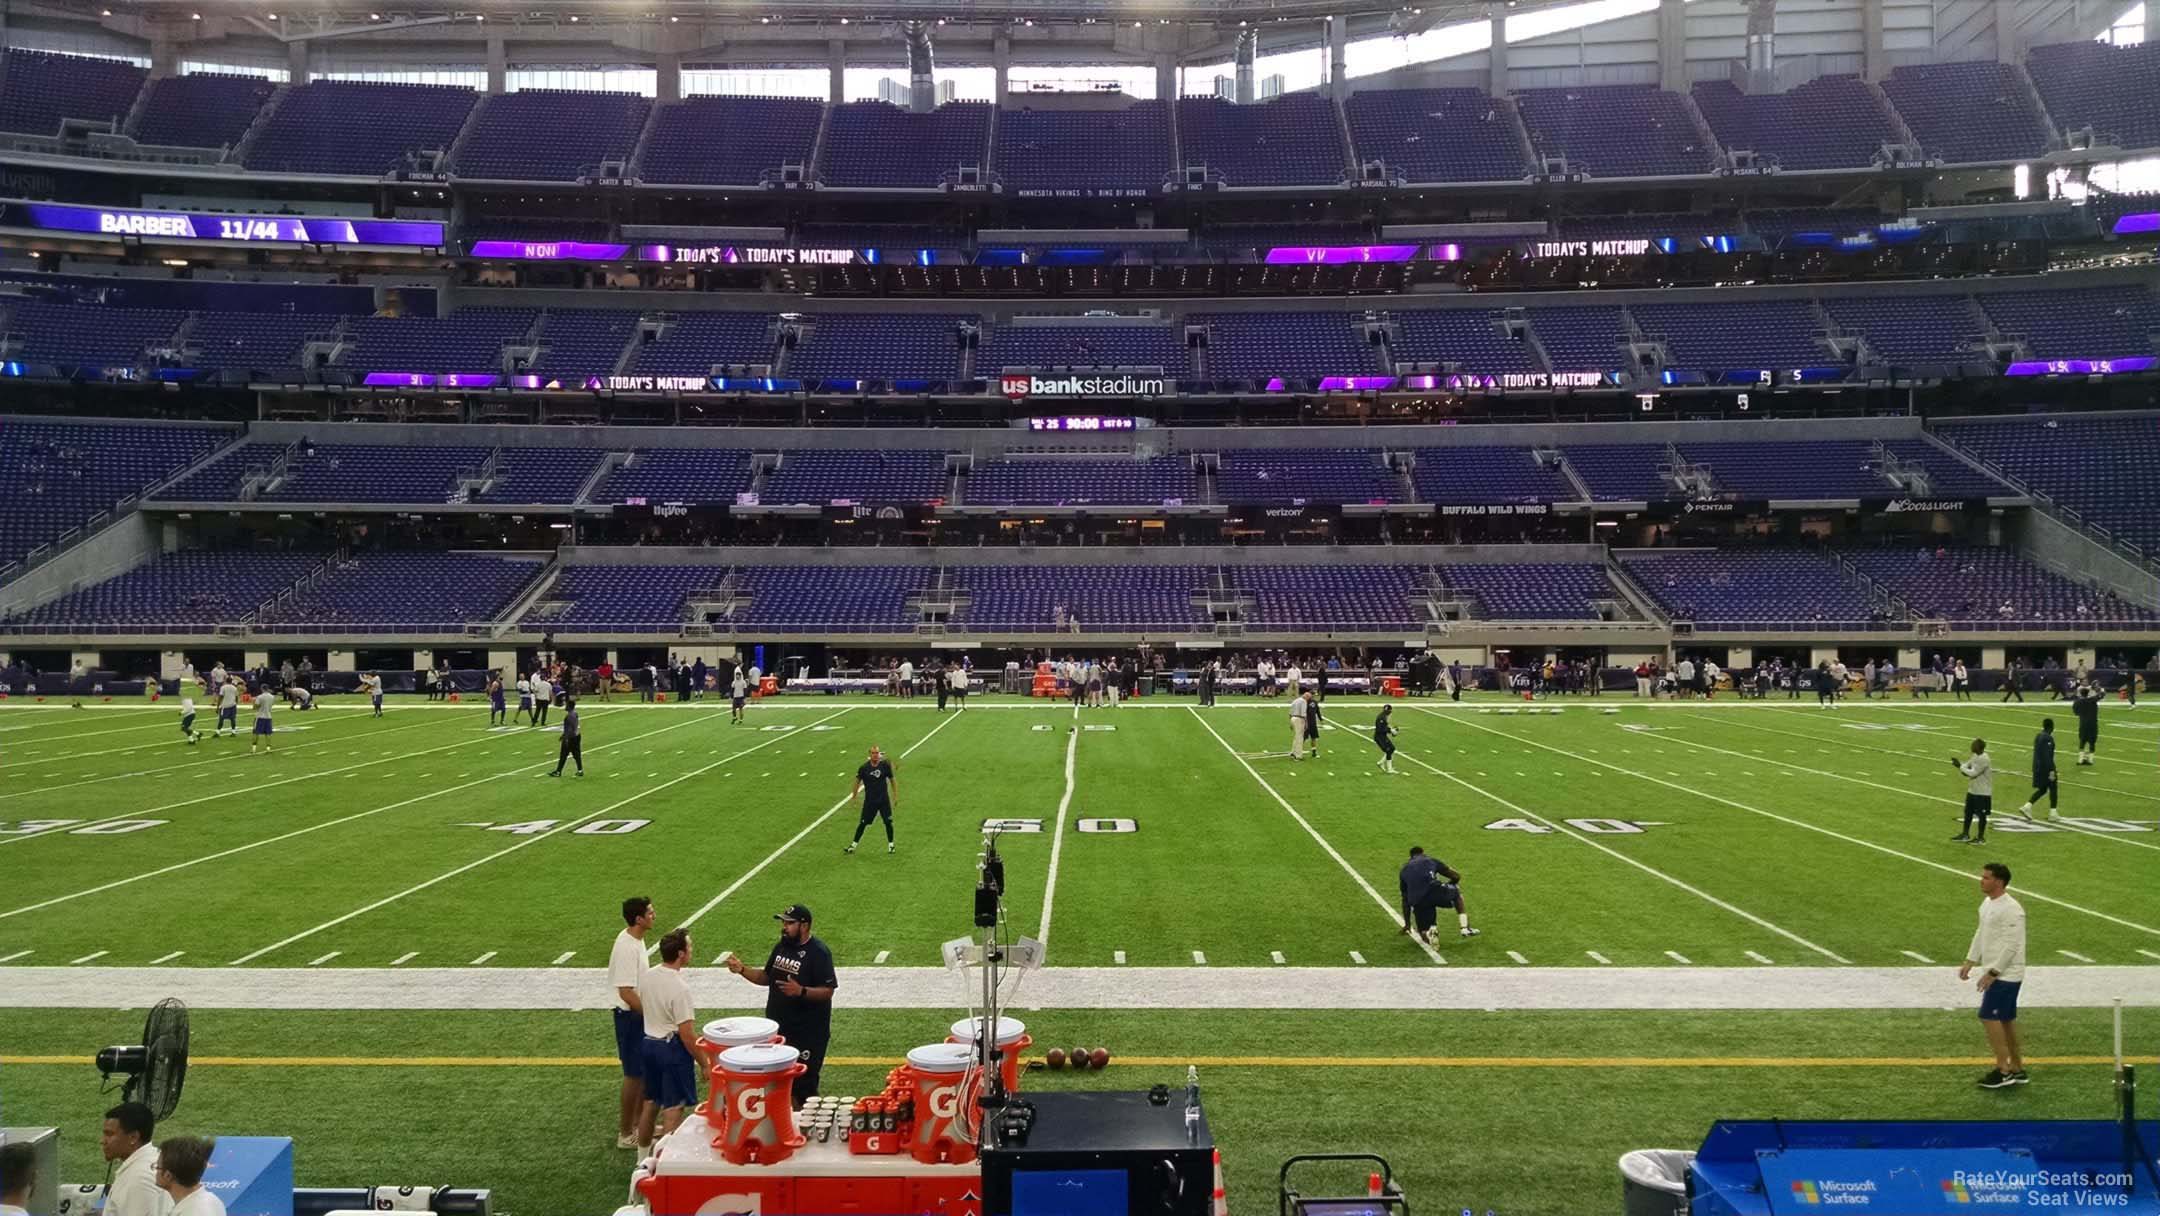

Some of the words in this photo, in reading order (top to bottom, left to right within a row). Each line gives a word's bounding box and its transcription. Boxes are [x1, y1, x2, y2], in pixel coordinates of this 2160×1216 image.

[101, 213, 187, 236] BARBER
[220, 220, 279, 240] 11/44
[746, 248, 796, 263] TODAY'S
[800, 250, 854, 264] MATCHUP
[1537, 241, 1588, 257] TODAY'S
[1592, 240, 1649, 256] MATCHUP
[608, 376, 653, 389] TODAY'S
[657, 377, 707, 391] MATCHUP
[1503, 374, 1548, 387] TODAY'S
[1551, 372, 1602, 386] MATCHUP
[1265, 507, 1301, 517] verizon
[1442, 505, 1486, 515] BUFFALO
[1487, 505, 1513, 514] WILD
[1514, 504, 1547, 514] WINGS
[1901, 498, 1933, 512] Coors
[1933, 502, 1964, 510] LIGHT
[774, 955, 802, 972] RAMS
[737, 1087, 766, 1120] G
[929, 1086, 958, 1118] G
[870, 1118, 881, 1130] G
[867, 1136, 880, 1151] G
[1818, 1180, 1877, 1192] Microsoft
[1823, 1193, 1870, 1204] Surface
